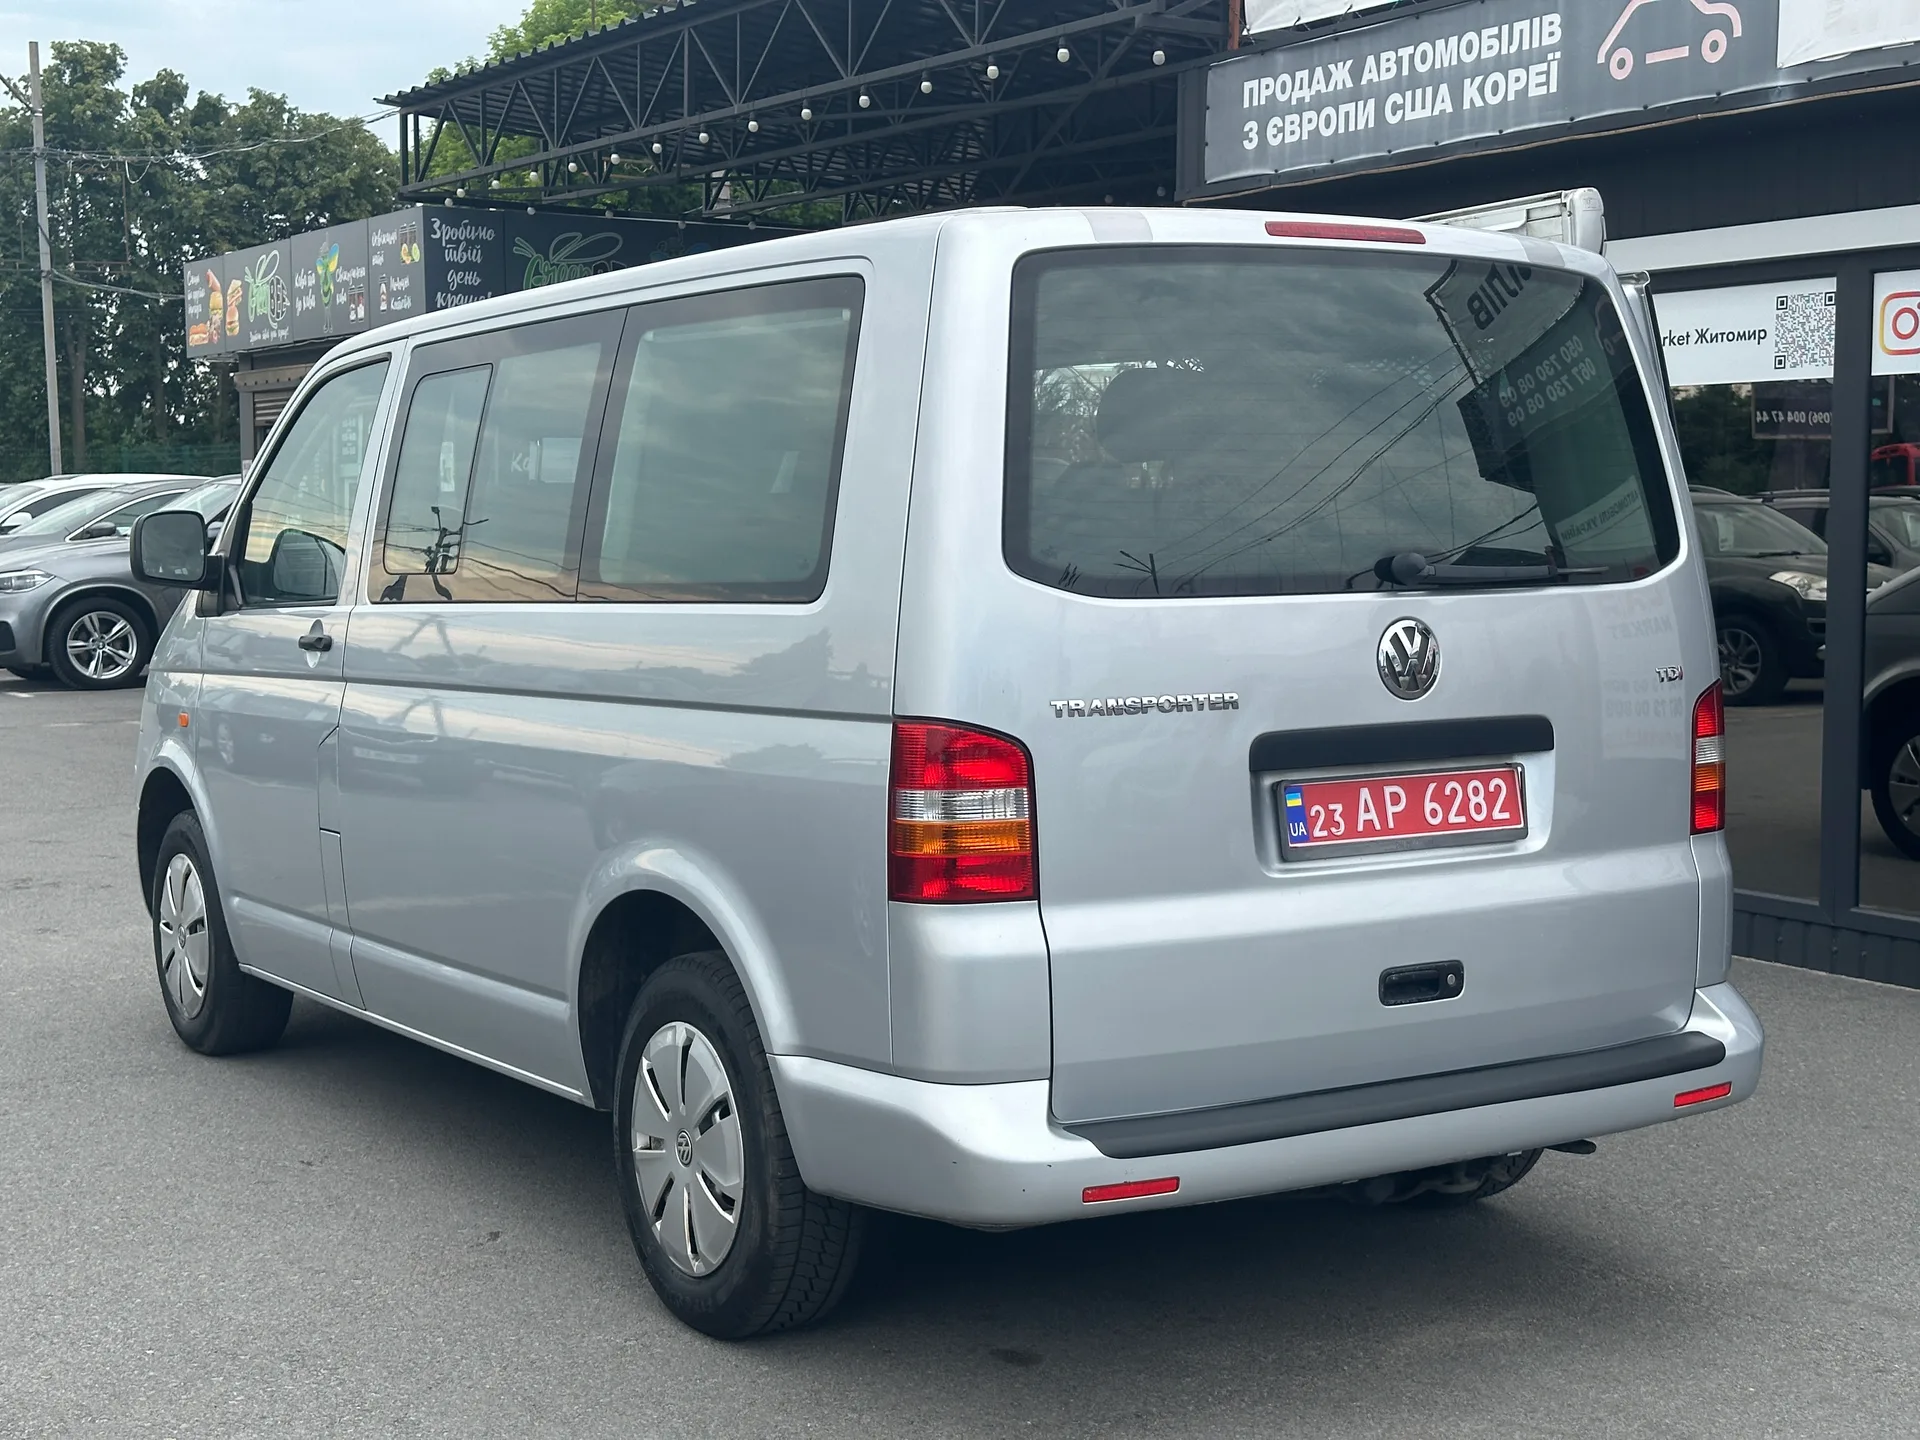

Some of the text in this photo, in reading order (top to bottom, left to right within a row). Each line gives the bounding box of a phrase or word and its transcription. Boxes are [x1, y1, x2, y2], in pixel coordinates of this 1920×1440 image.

[1243, 13, 1562, 108] ПРОДАЖ АВТОМОБІЛІВ
[1242, 52, 1561, 150] З ЄВРОПИ США КОРЕЇ
[430, 218, 495, 246] Зробимо
[444, 241, 483, 263] твій
[447, 269, 481, 291] день
[1694, 328, 1767, 345] Житомир
[1655, 665, 1683, 682] TDI
[1050, 692, 1239, 719] TRANSPORTER
[1290, 777, 1511, 838] UA 23 AP 6282
